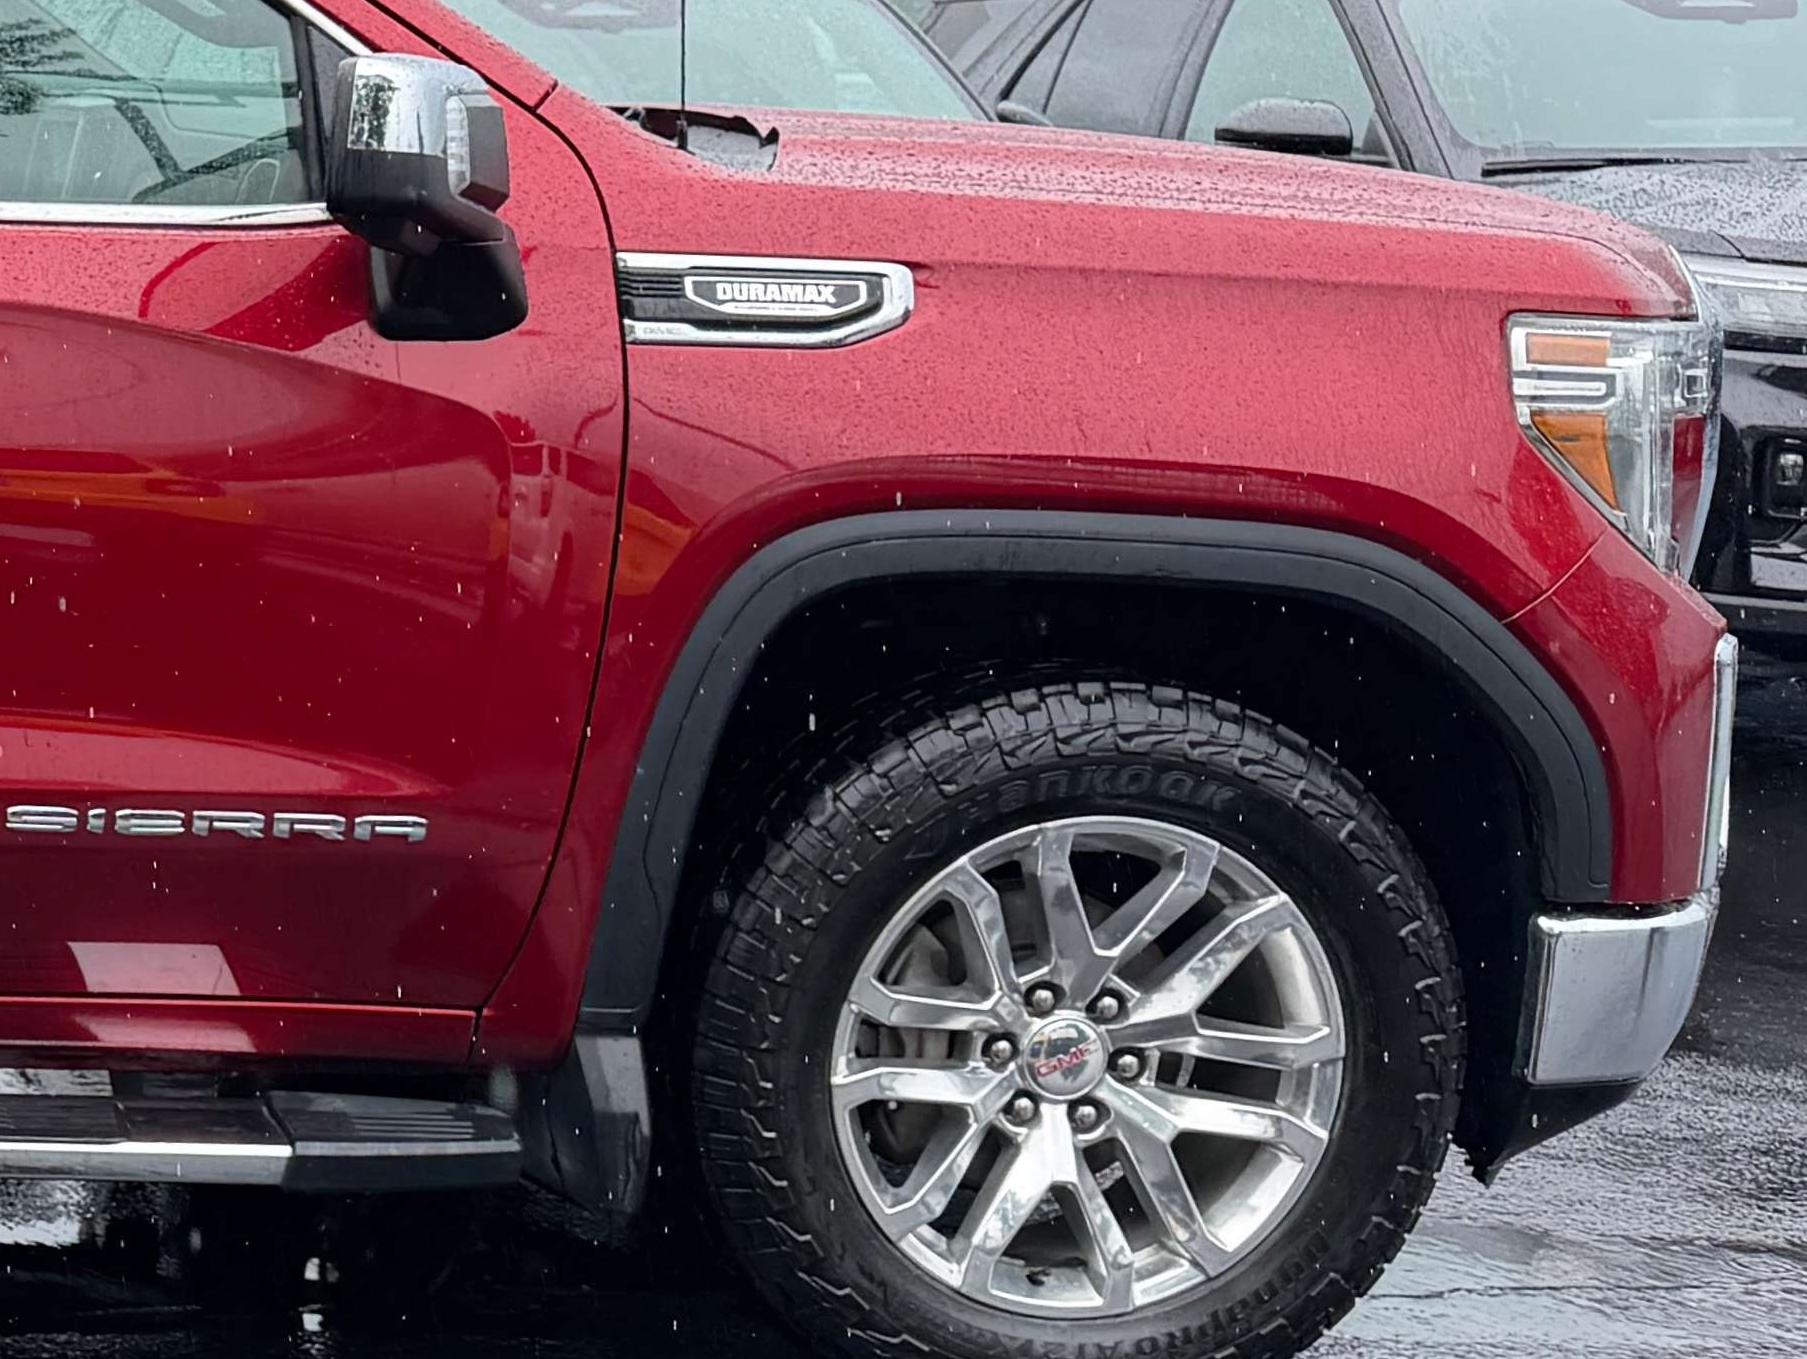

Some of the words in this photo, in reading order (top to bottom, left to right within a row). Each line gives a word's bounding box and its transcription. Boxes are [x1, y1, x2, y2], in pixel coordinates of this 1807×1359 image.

[715, 281, 837, 304] DURAMAX
[4, 804, 430, 842] SIERRA
[1036, 1039, 1099, 1078] GMC
